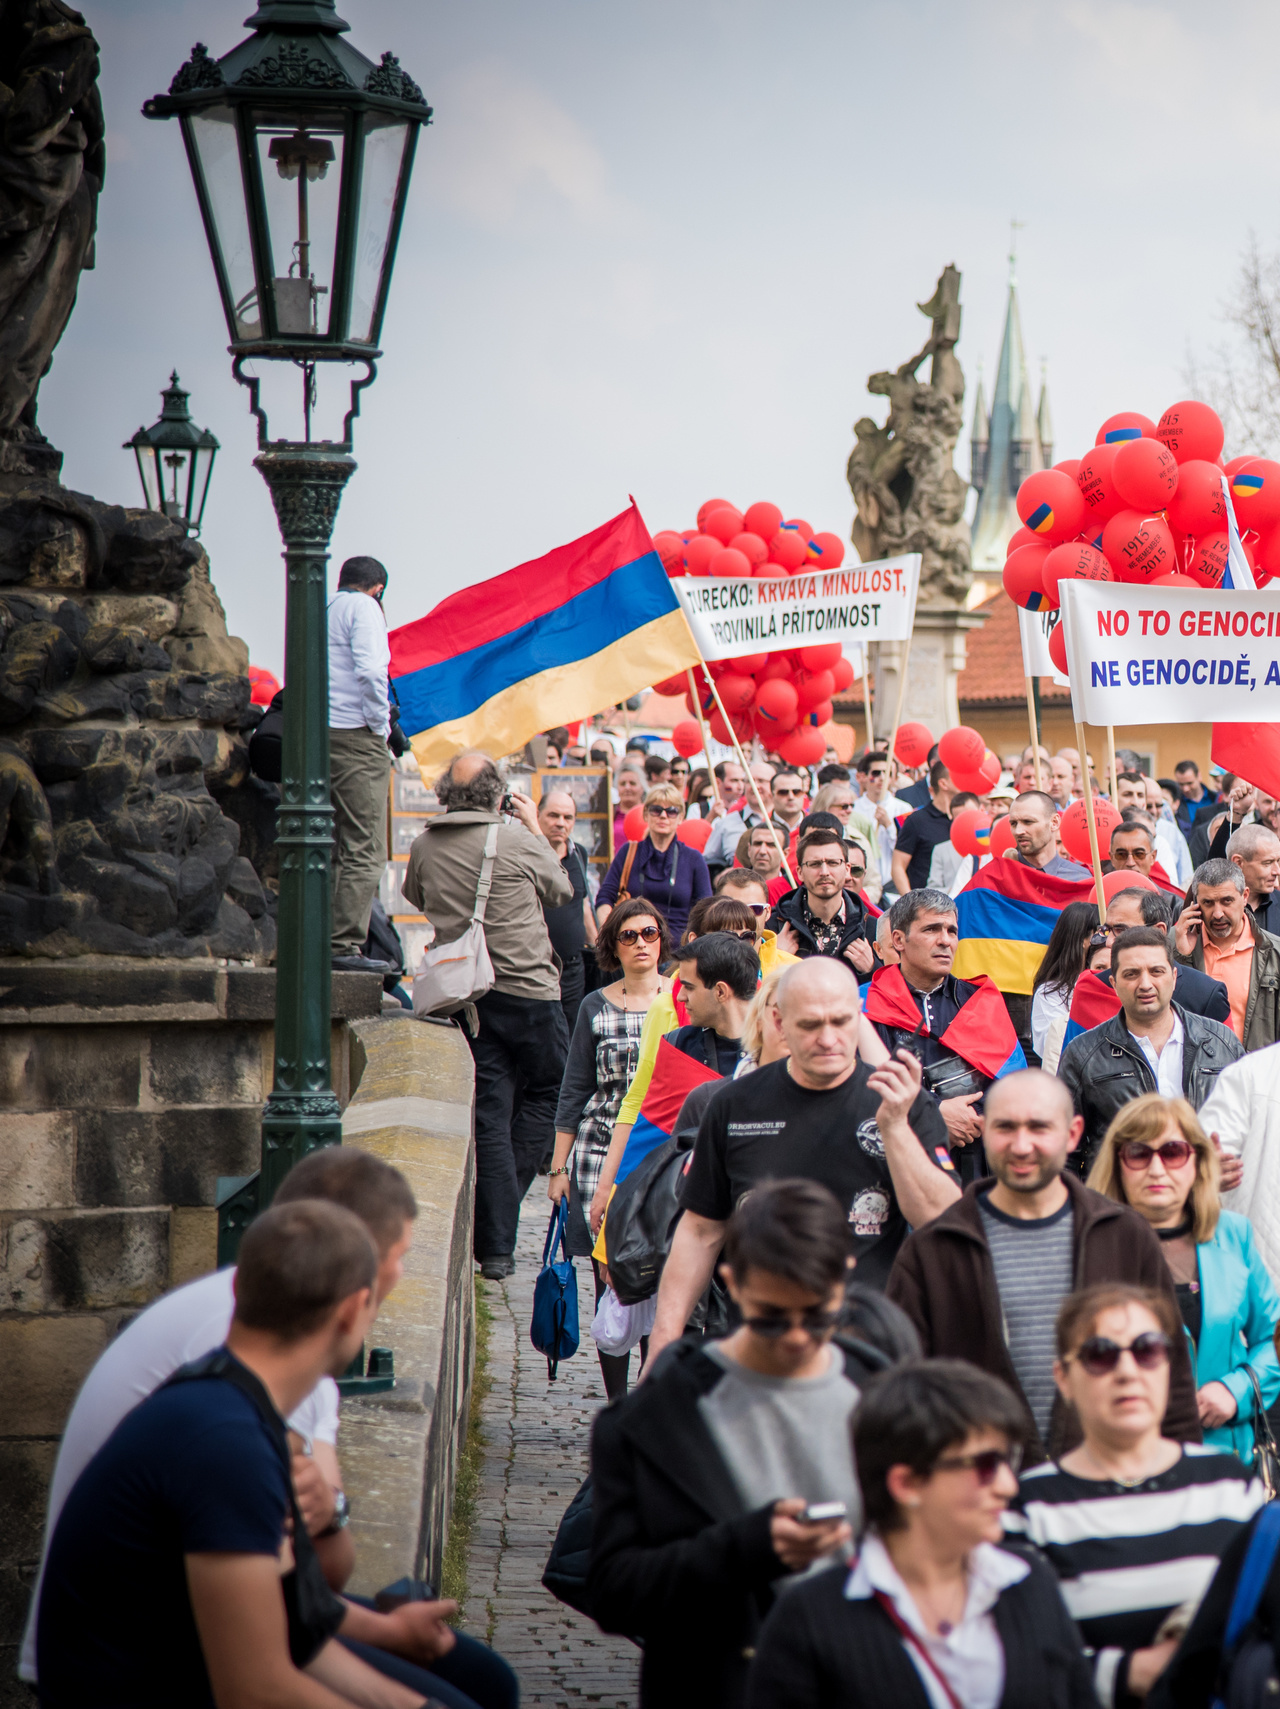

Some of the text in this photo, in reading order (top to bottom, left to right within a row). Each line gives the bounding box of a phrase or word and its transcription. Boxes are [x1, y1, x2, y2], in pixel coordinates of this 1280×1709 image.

[1159, 414, 1179, 427] 915
[1157, 450, 1174, 467] 191
[1122, 528, 1150, 558] 1915
[1128, 533, 1162, 570] WE REMEMBER
[1212, 540, 1228, 557] 19
[1074, 549, 1093, 579] 1915
[1140, 547, 1167, 575] 2015
[686, 583, 753, 615] TURECKO:
[822, 568, 906, 599] MINULOST,
[711, 603, 881, 646] PROVINILÁ PŘÍTOMNOST
[1097, 610, 1130, 637] NO
[1138, 610, 1171, 636] TO
[1091, 660, 1121, 688] NE
[1126, 653, 1256, 691] GENOCIDĚ,
[1080, 800, 1107, 808] 115
[1081, 817, 1109, 829] 215
